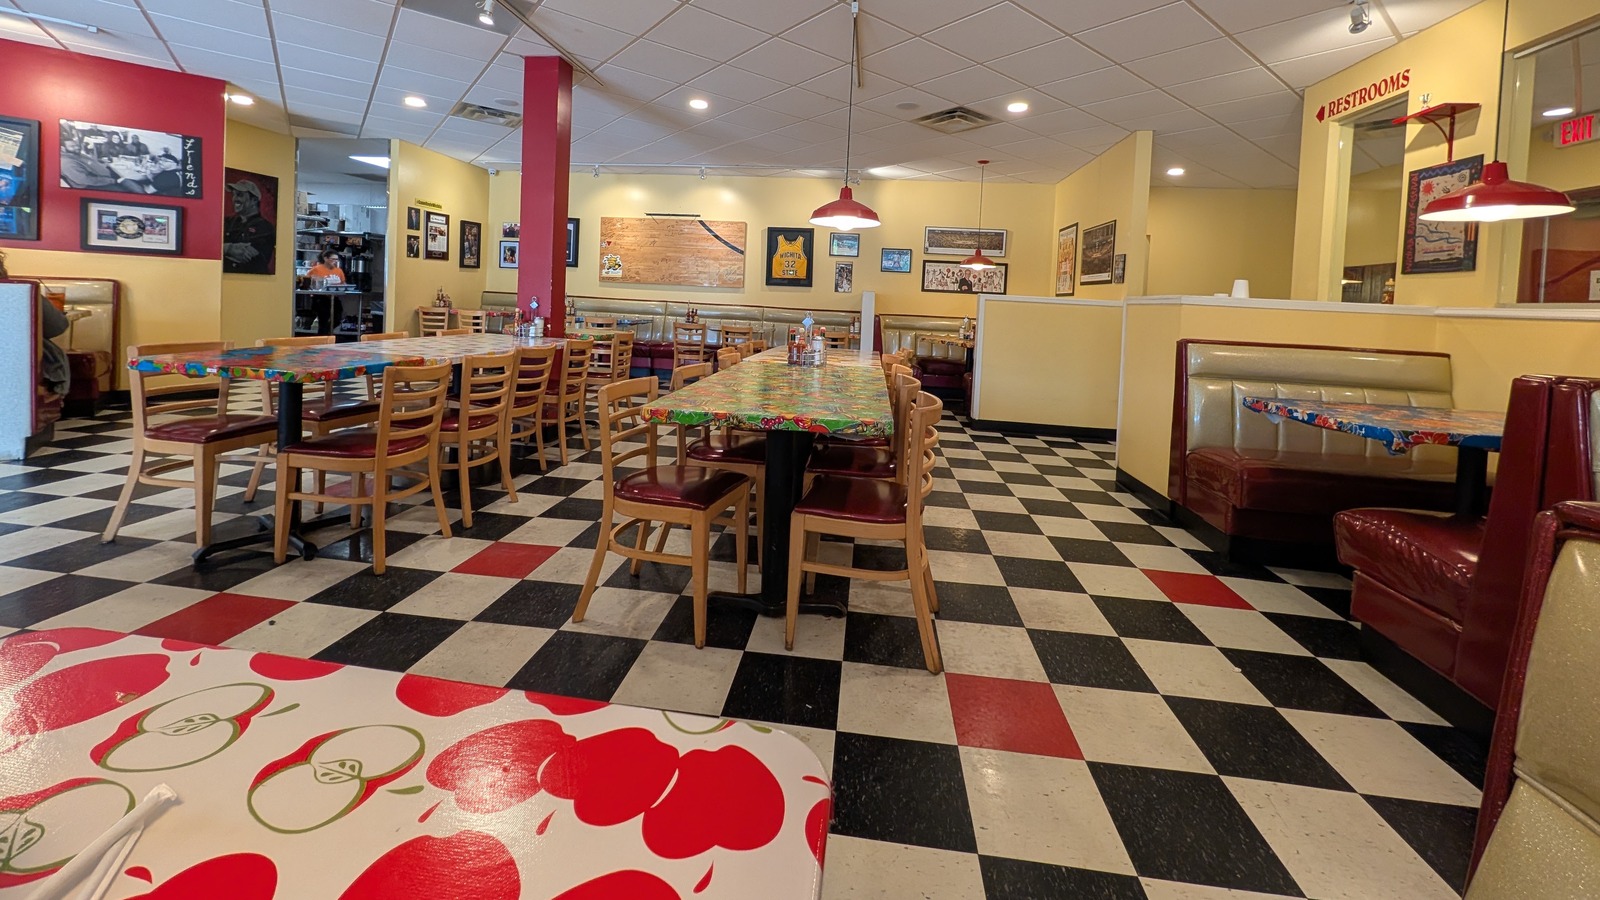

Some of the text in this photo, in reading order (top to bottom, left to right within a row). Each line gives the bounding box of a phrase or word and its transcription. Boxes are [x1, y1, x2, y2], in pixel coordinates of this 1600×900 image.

[1328, 69, 1411, 118] RESTROOMS
[1561, 115, 1594, 145] EXIT
[780, 252, 801, 260] WICHITA
[785, 260, 796, 268] 32
